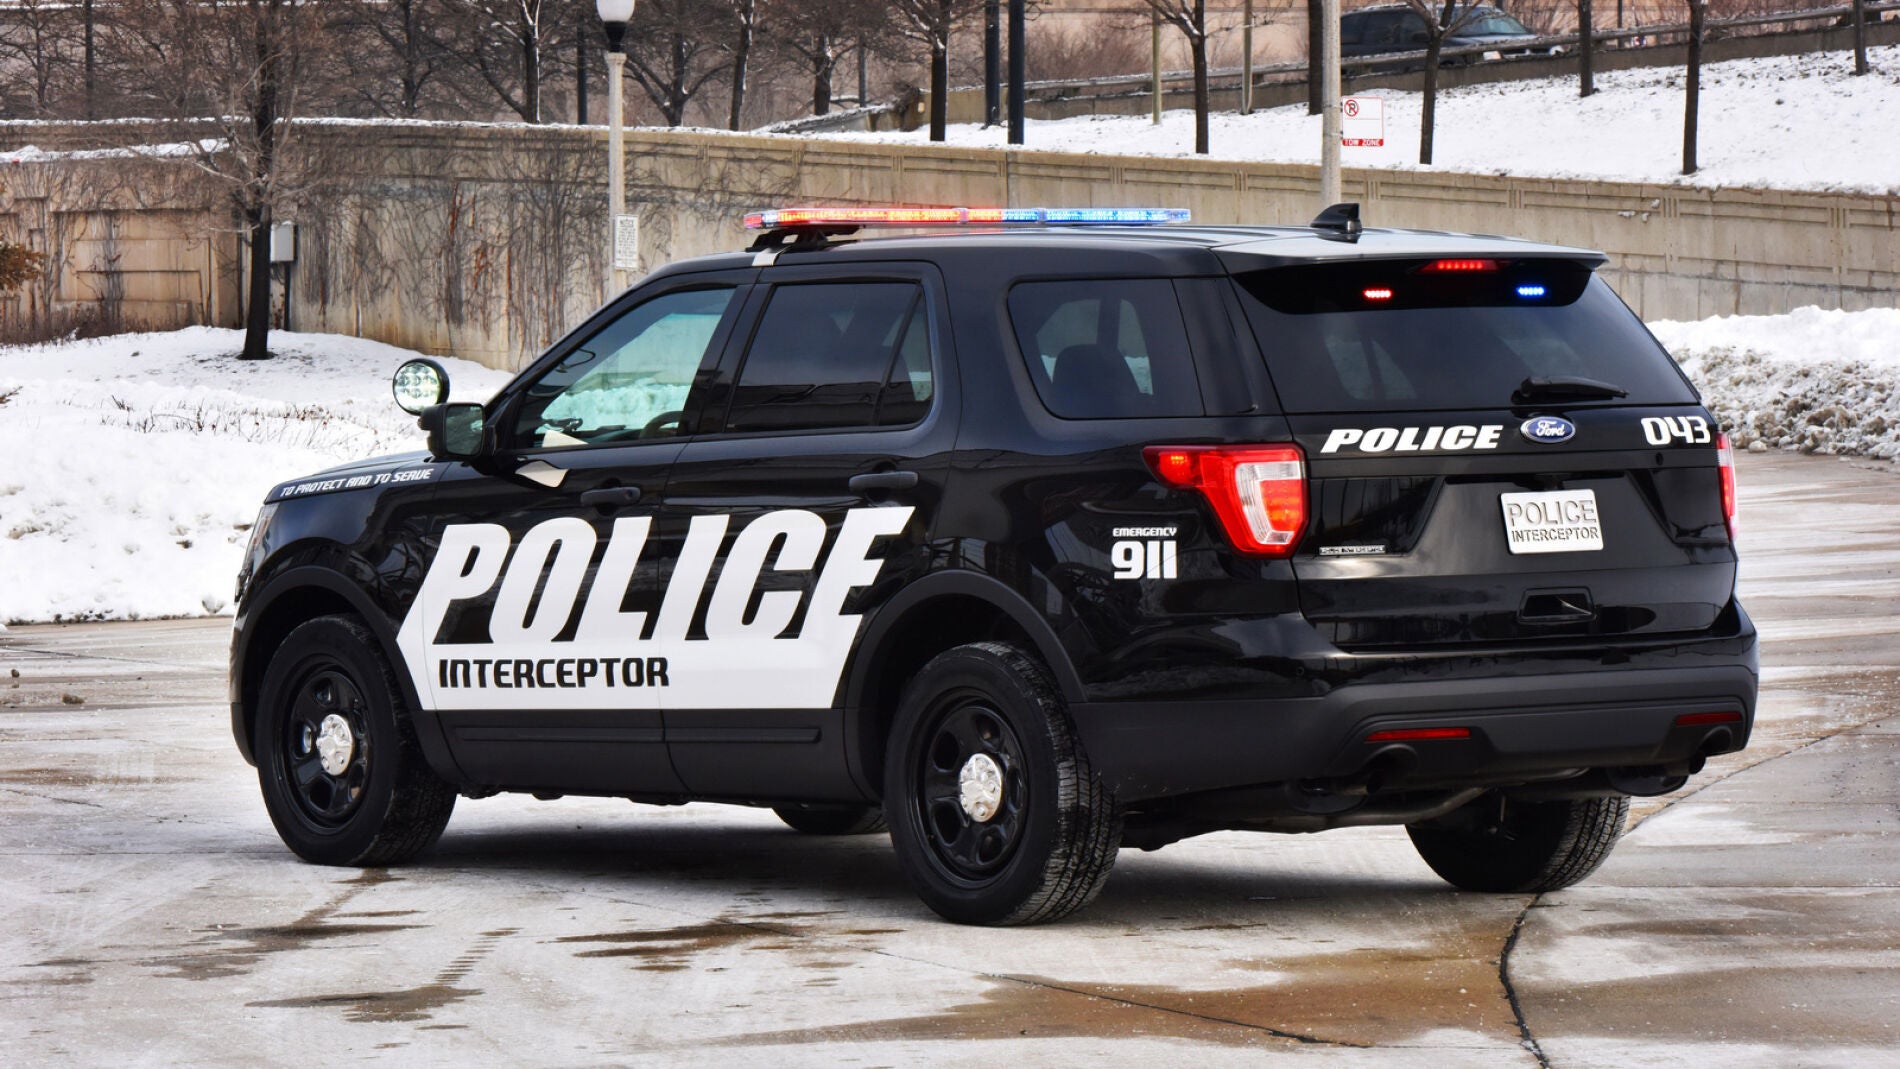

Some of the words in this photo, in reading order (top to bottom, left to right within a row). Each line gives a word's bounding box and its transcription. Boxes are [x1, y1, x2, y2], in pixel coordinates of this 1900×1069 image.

[1320, 425, 1504, 454] POLICE
[1536, 420, 1566, 436] Ford
[1640, 415, 1711, 446] 043
[279, 486, 295, 498] TO
[294, 478, 344, 495] PROTECT
[345, 475, 371, 488] AND
[373, 472, 392, 485] TO
[391, 468, 434, 483] SERVE
[1507, 500, 1597, 527] POLICE
[1112, 527, 1178, 537] EMERGENCY
[1511, 526, 1600, 543] INTERCEPTOR
[1111, 540, 1178, 579] 911
[397, 505, 916, 646] POLICE
[438, 656, 670, 689] INTERCEPTOR
